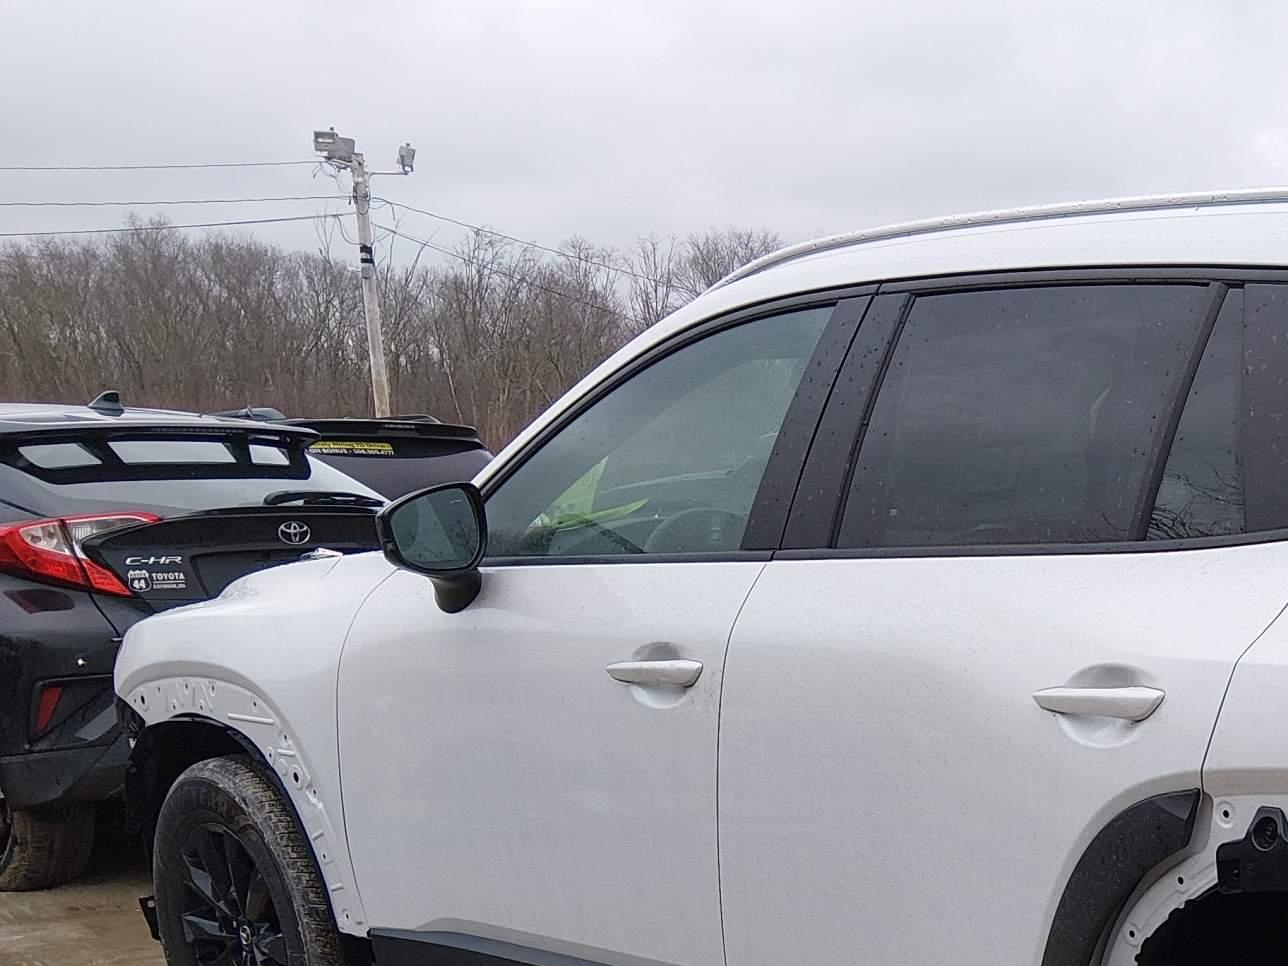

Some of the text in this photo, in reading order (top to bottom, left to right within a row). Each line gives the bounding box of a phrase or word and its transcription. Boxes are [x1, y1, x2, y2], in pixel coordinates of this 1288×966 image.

[125, 555, 183, 566] C-HR
[151, 572, 185, 581] TOYOTA
[133, 579, 146, 589] 44
